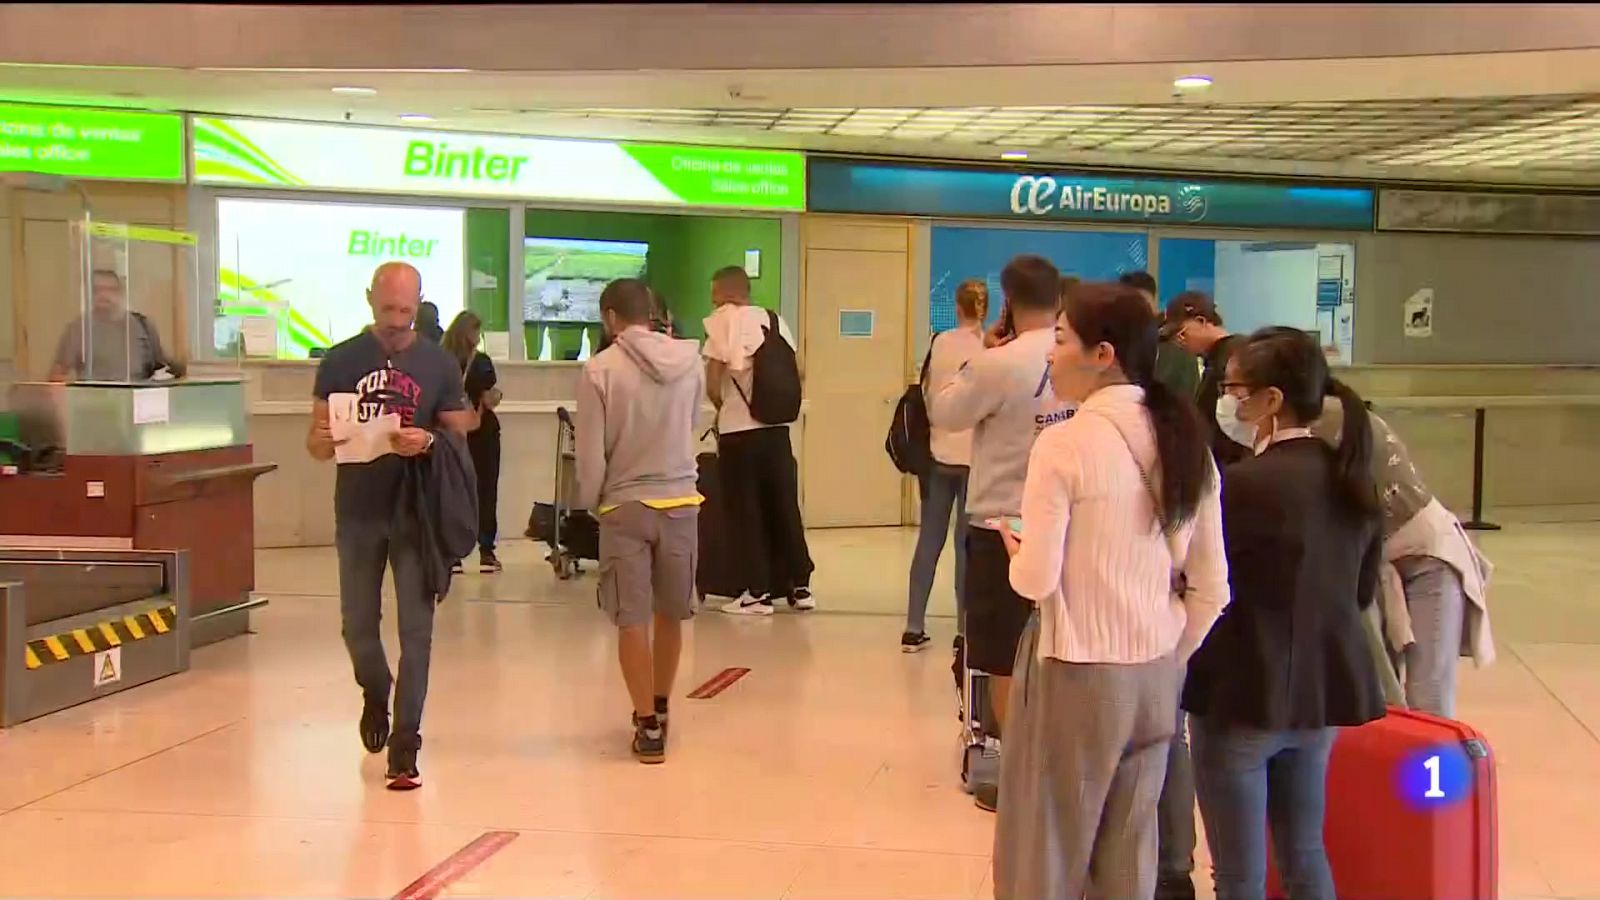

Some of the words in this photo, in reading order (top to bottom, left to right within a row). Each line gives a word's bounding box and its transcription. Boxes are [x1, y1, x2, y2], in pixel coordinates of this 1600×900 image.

[37, 144, 91, 161] office
[403, 140, 529, 183] Binter
[347, 229, 439, 257] Binter
[355, 369, 421, 407] TOMMY
